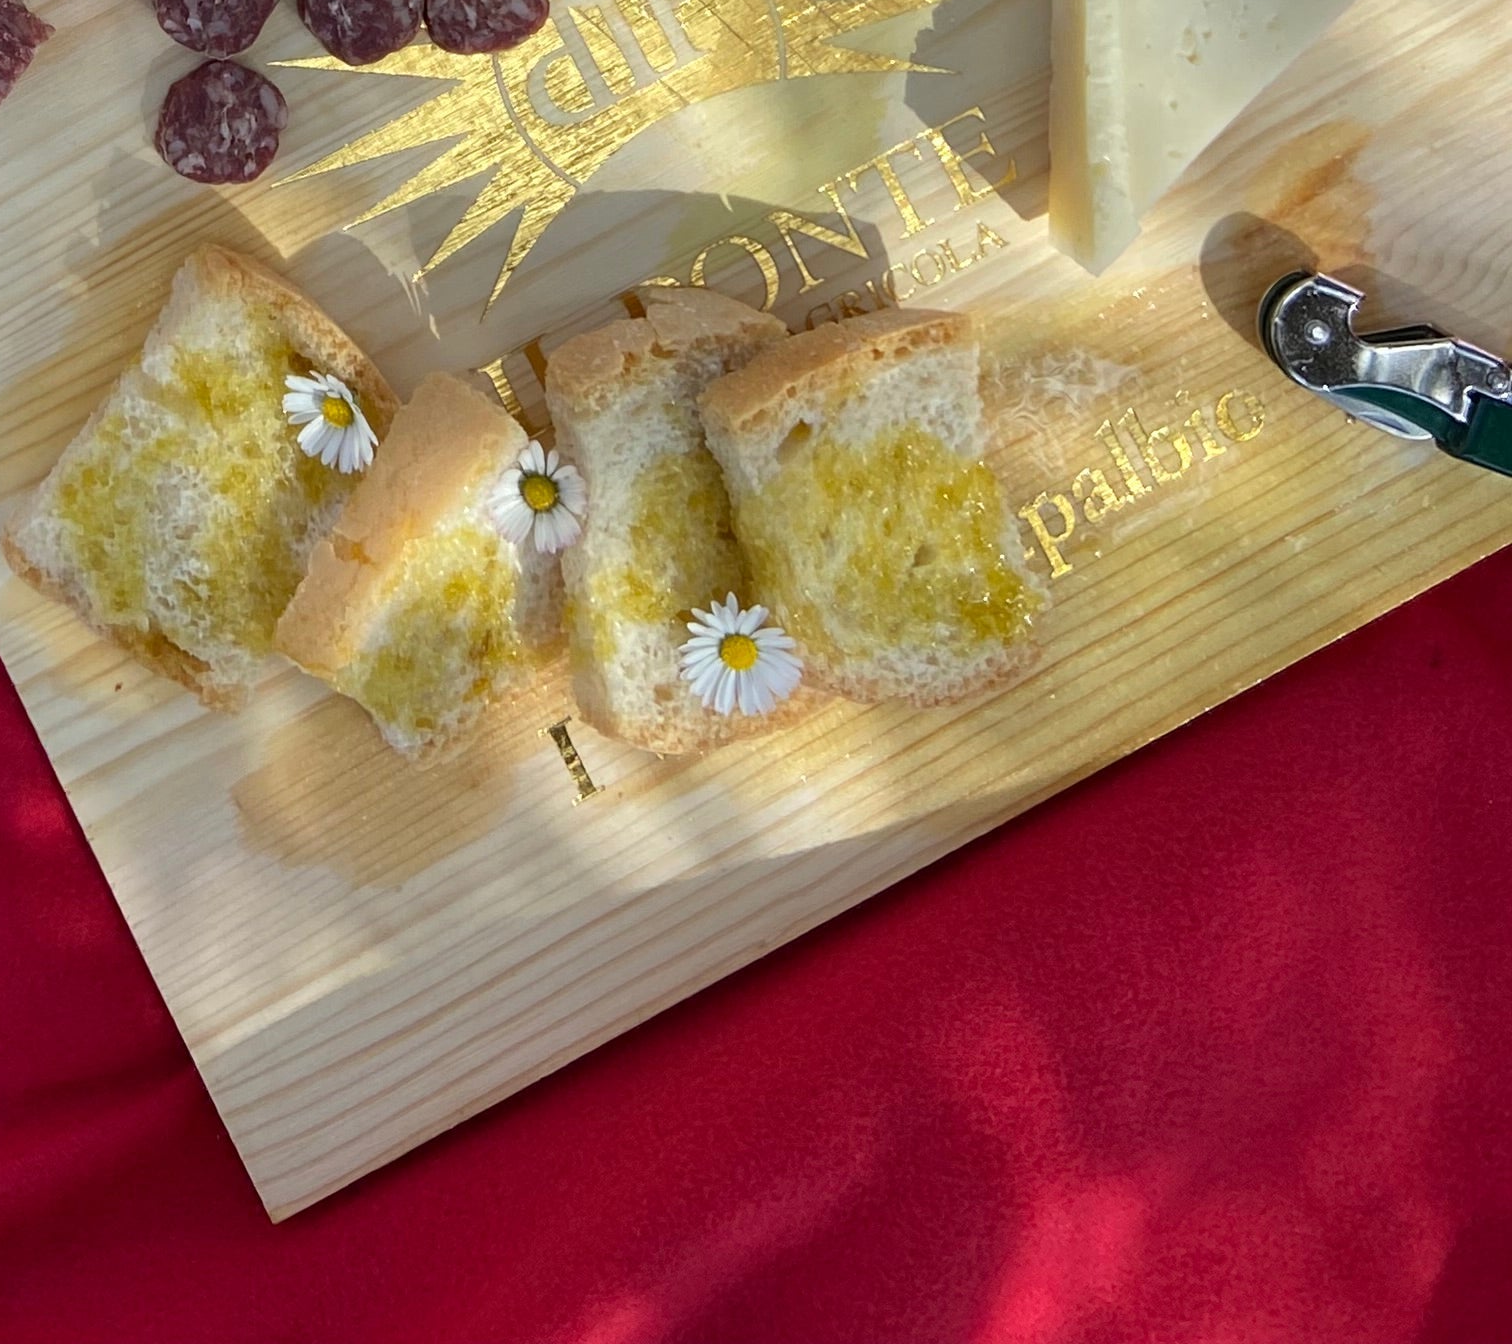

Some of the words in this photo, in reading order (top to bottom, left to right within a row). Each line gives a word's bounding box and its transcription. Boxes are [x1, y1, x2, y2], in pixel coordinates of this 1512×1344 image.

[610, 105, 1019, 318] ONTE
[788, 219, 1010, 335] GRICOLA
[1017, 388, 1266, 580] palbio
